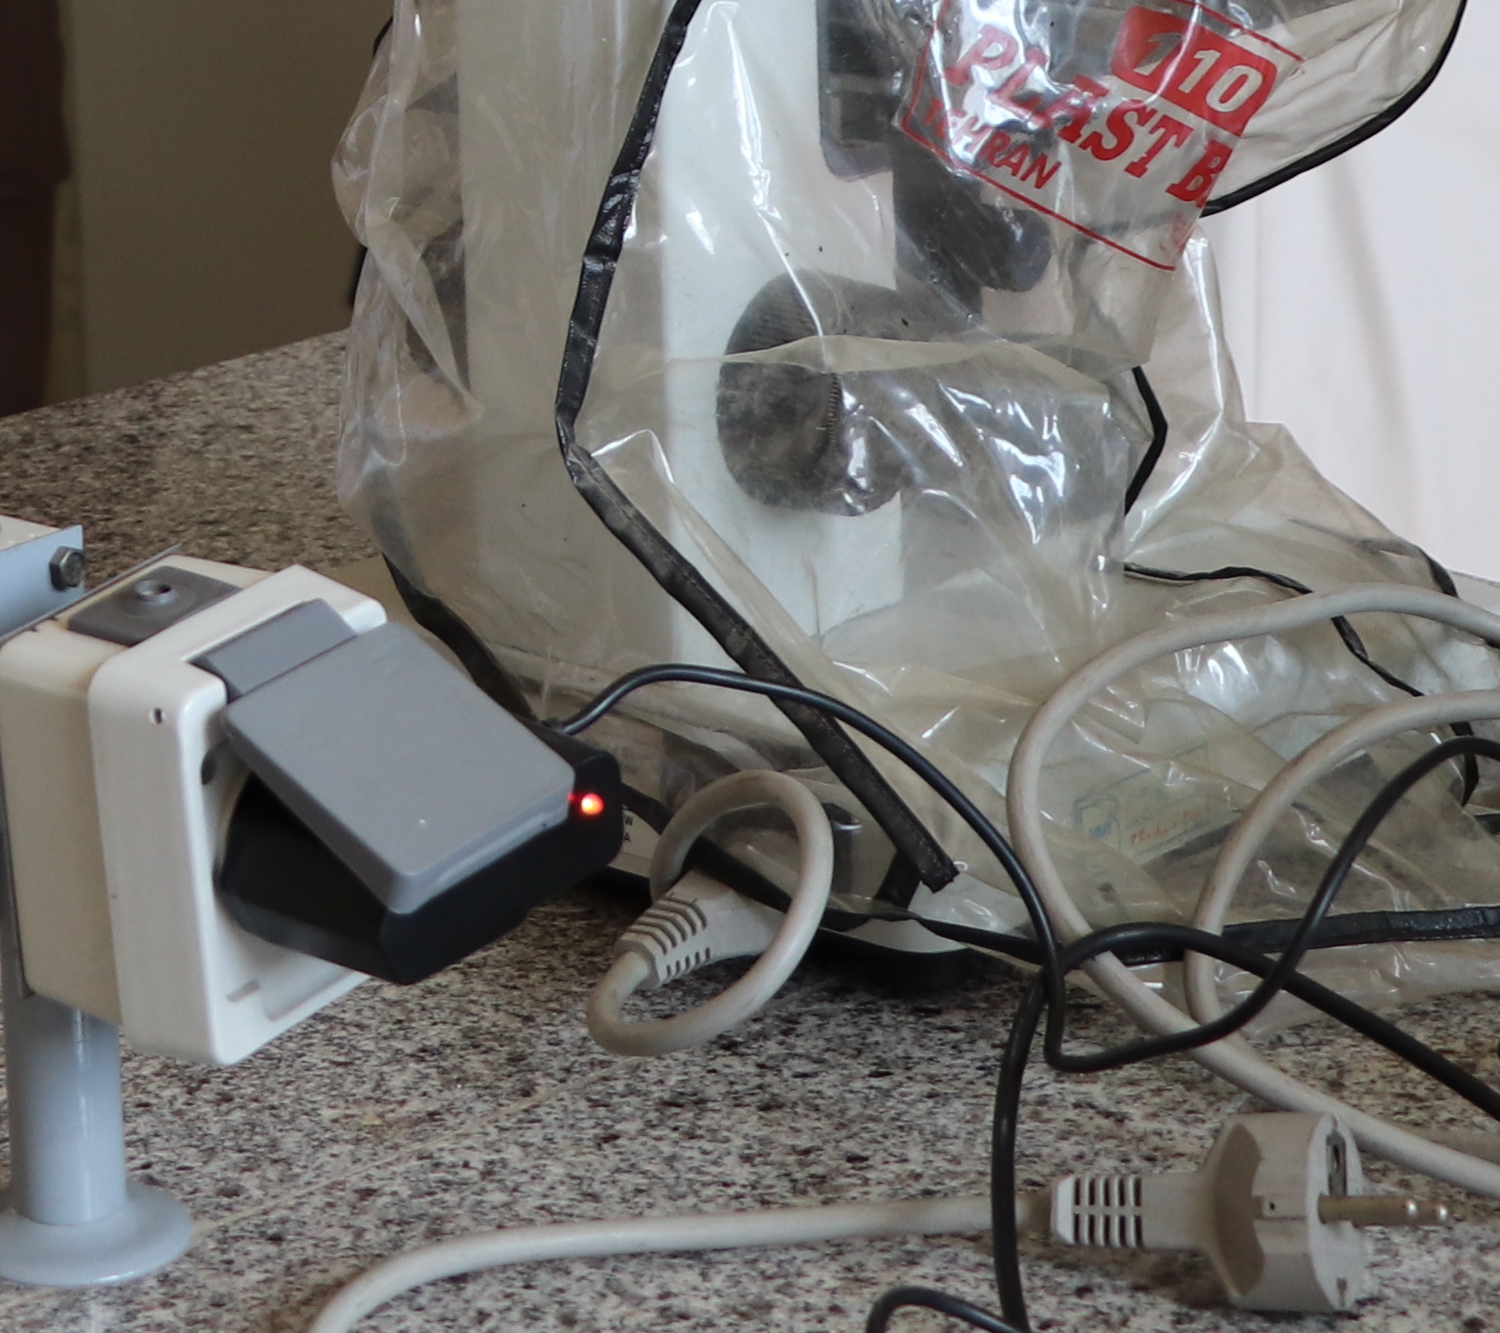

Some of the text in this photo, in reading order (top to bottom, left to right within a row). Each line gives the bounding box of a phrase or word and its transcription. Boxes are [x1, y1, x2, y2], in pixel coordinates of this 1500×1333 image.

[945, 24, 1233, 209] PLAST B
[1133, 30, 1264, 113] 110
[923, 96, 1062, 191] TEHRAN
